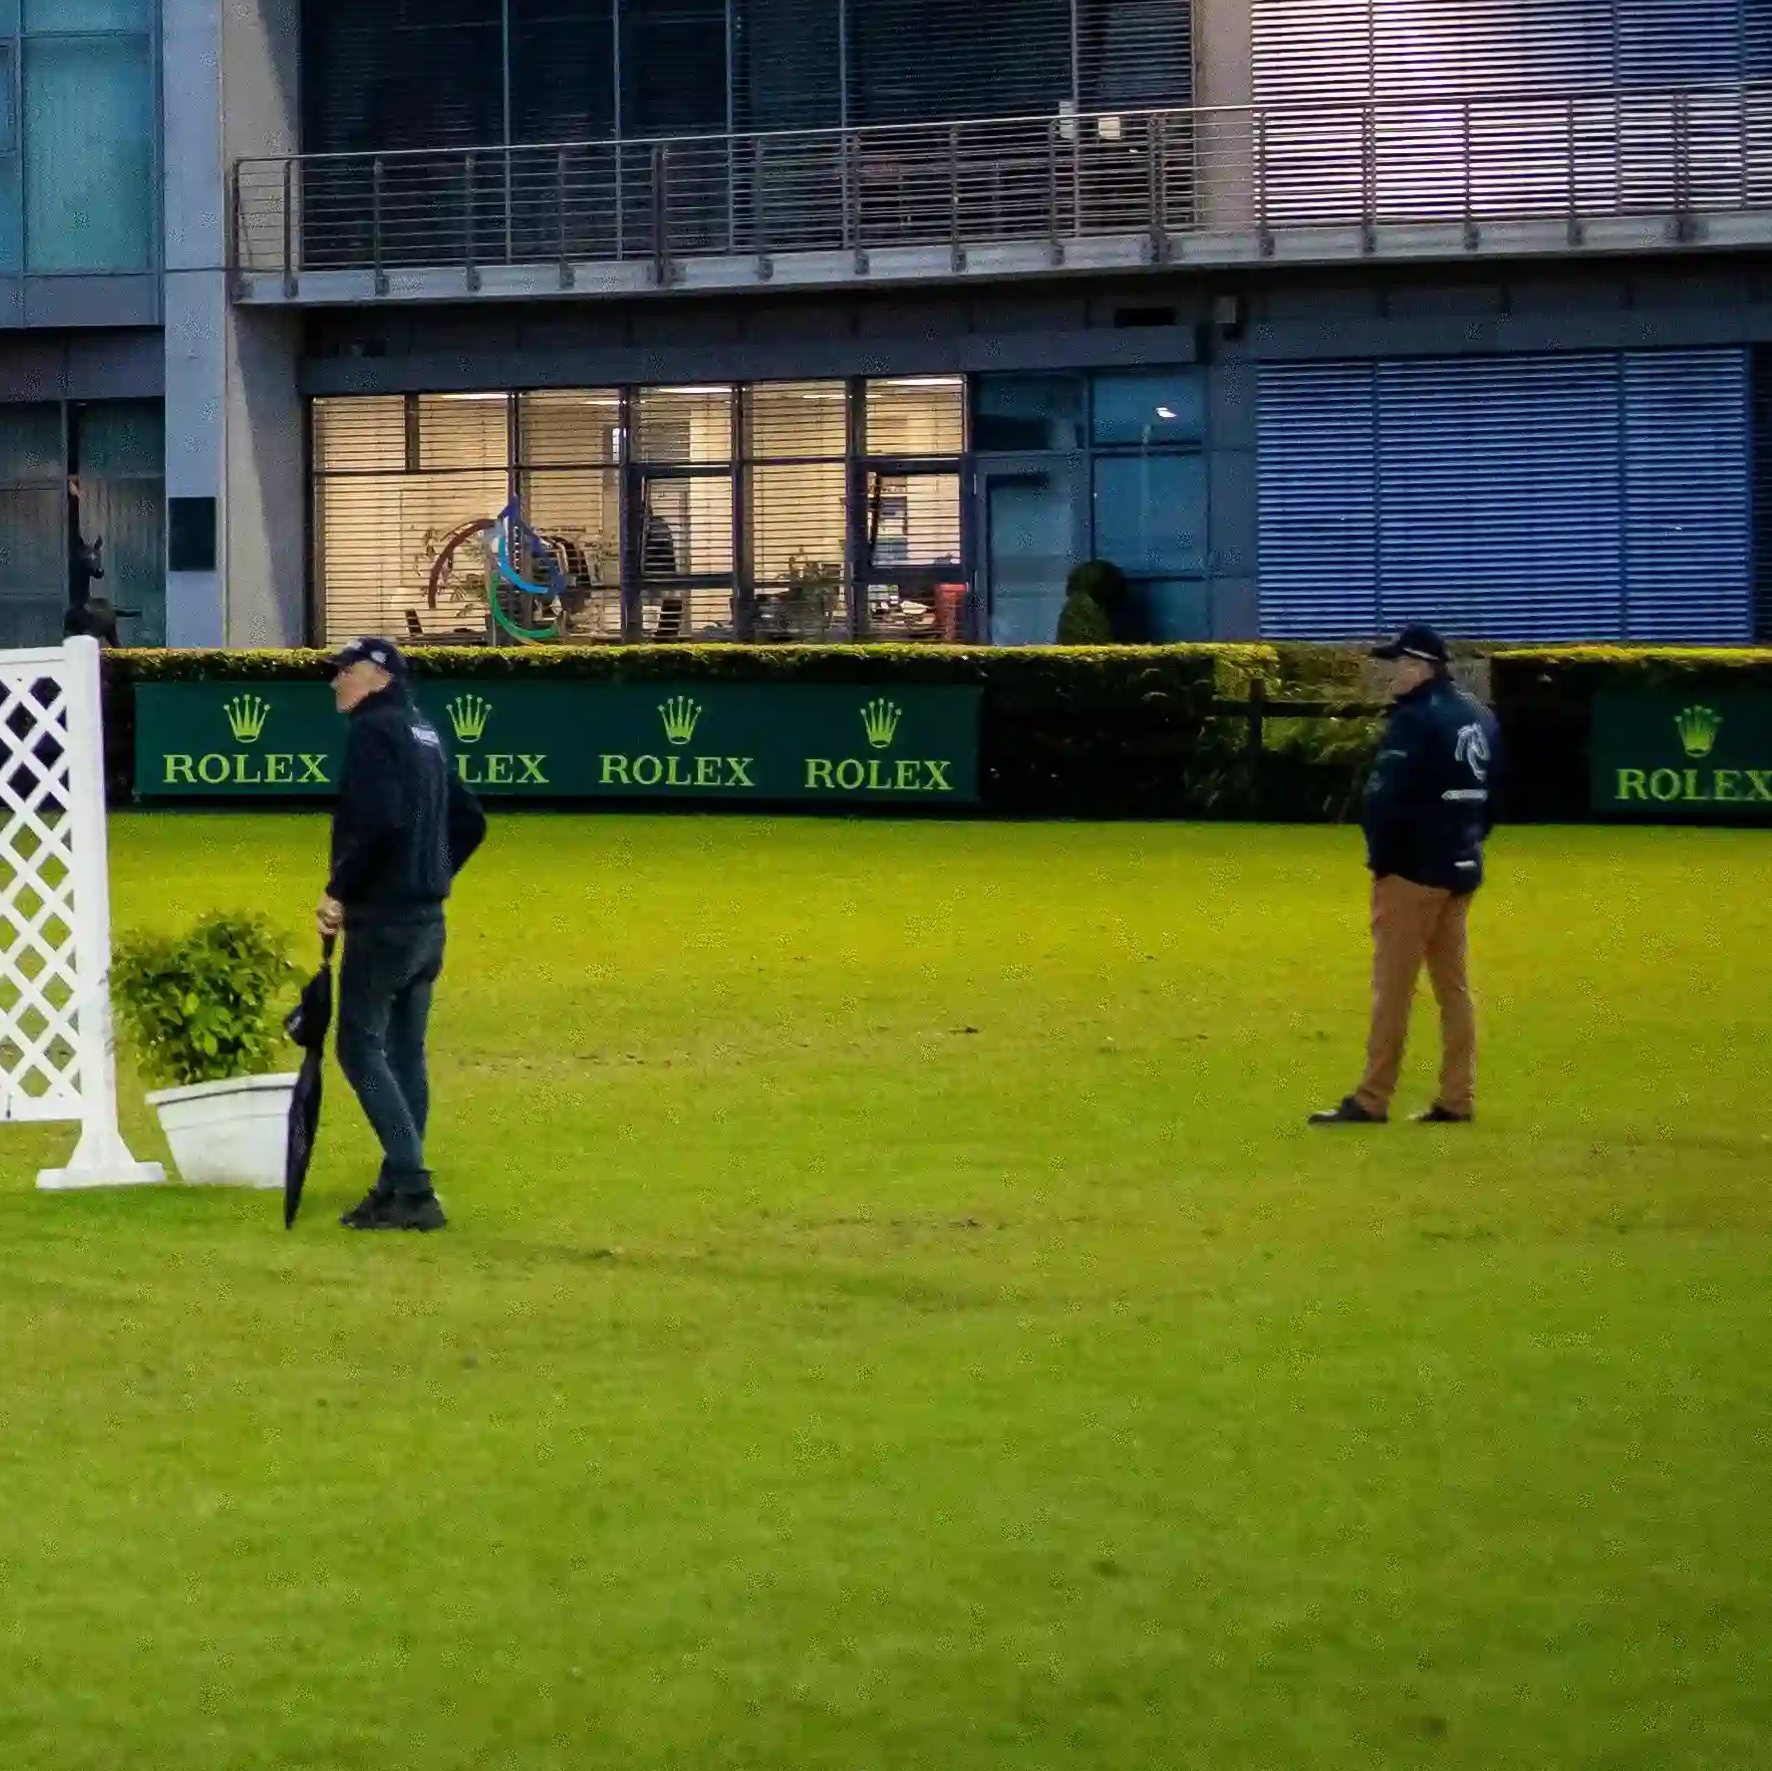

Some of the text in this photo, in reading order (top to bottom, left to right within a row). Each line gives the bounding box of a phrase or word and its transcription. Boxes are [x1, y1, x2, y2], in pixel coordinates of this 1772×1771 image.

[162, 753, 331, 784] ROLEX
[454, 754, 550, 784] LEX
[598, 754, 755, 787] ROLEX
[804, 758, 953, 791] ROLEX
[1614, 768, 1772, 801] ROLEX
